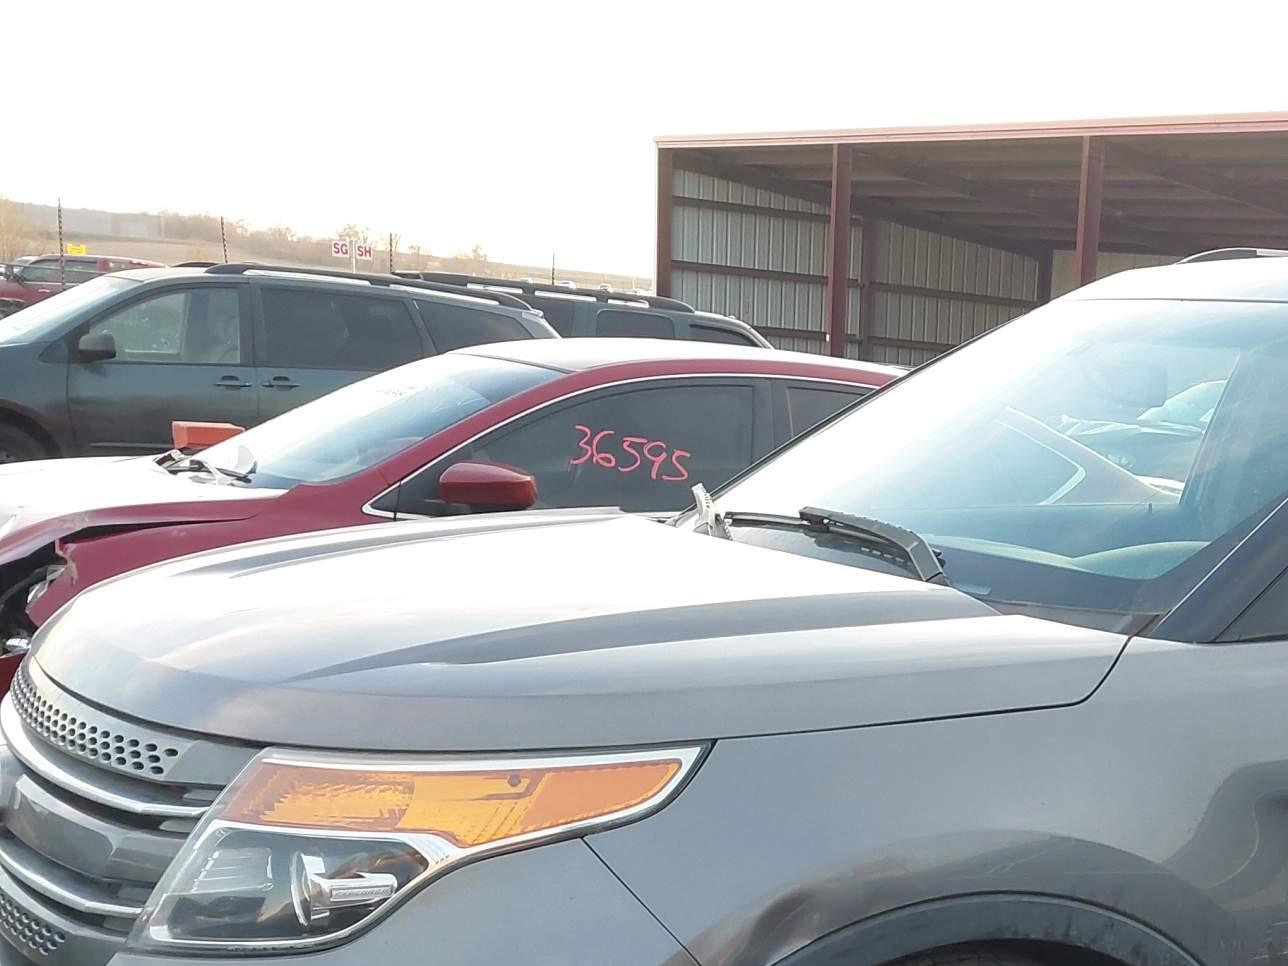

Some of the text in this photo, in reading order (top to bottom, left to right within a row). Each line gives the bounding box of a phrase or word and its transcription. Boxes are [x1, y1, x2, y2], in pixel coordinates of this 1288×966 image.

[333, 242, 348, 255] SG
[357, 245, 372, 257] SH
[570, 424, 691, 480] 36595
